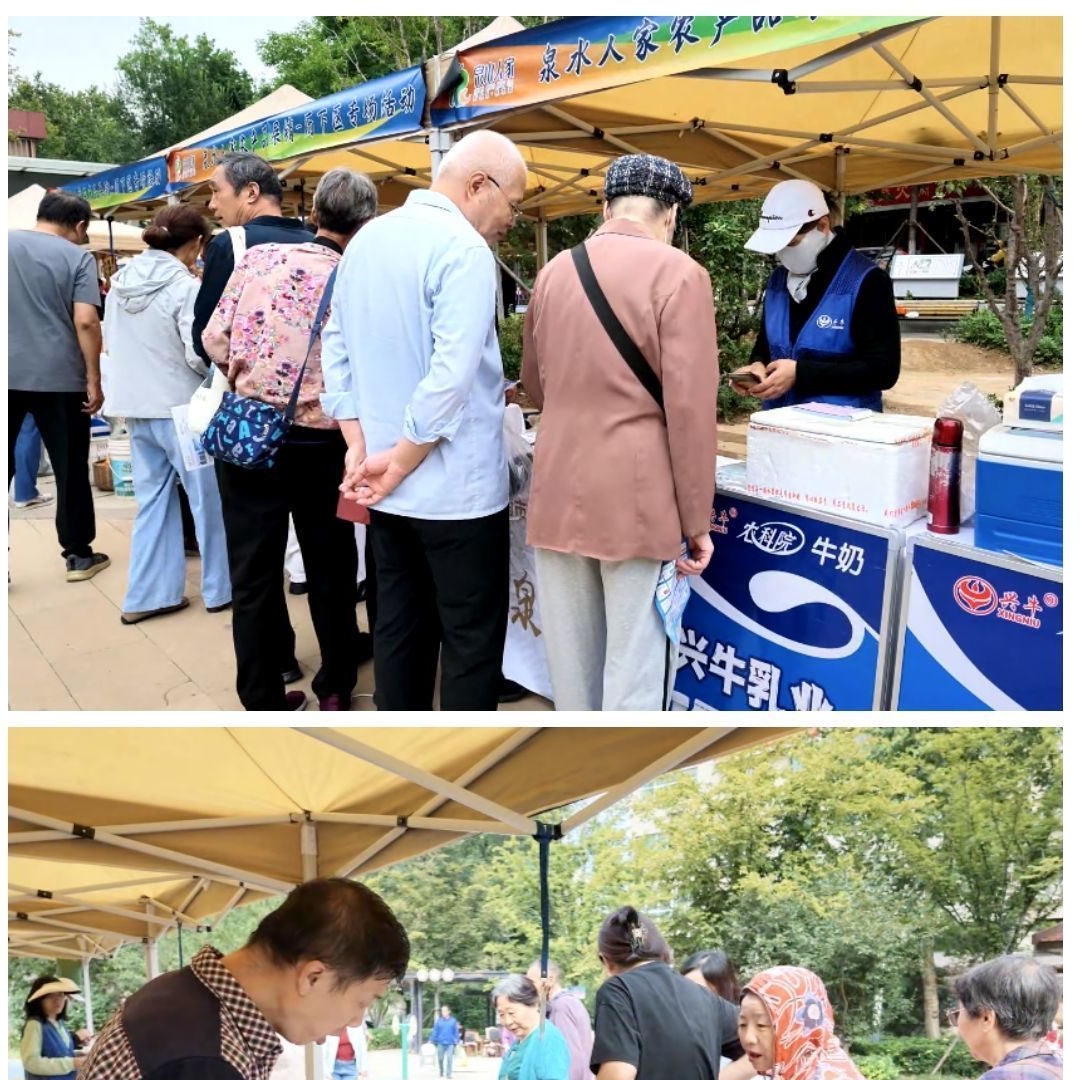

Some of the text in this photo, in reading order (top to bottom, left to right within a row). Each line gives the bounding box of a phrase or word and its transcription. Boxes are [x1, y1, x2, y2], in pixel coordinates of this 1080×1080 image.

[737, 522, 865, 576] 农科院 牛奶
[996, 607, 1041, 629] XINGNIU
